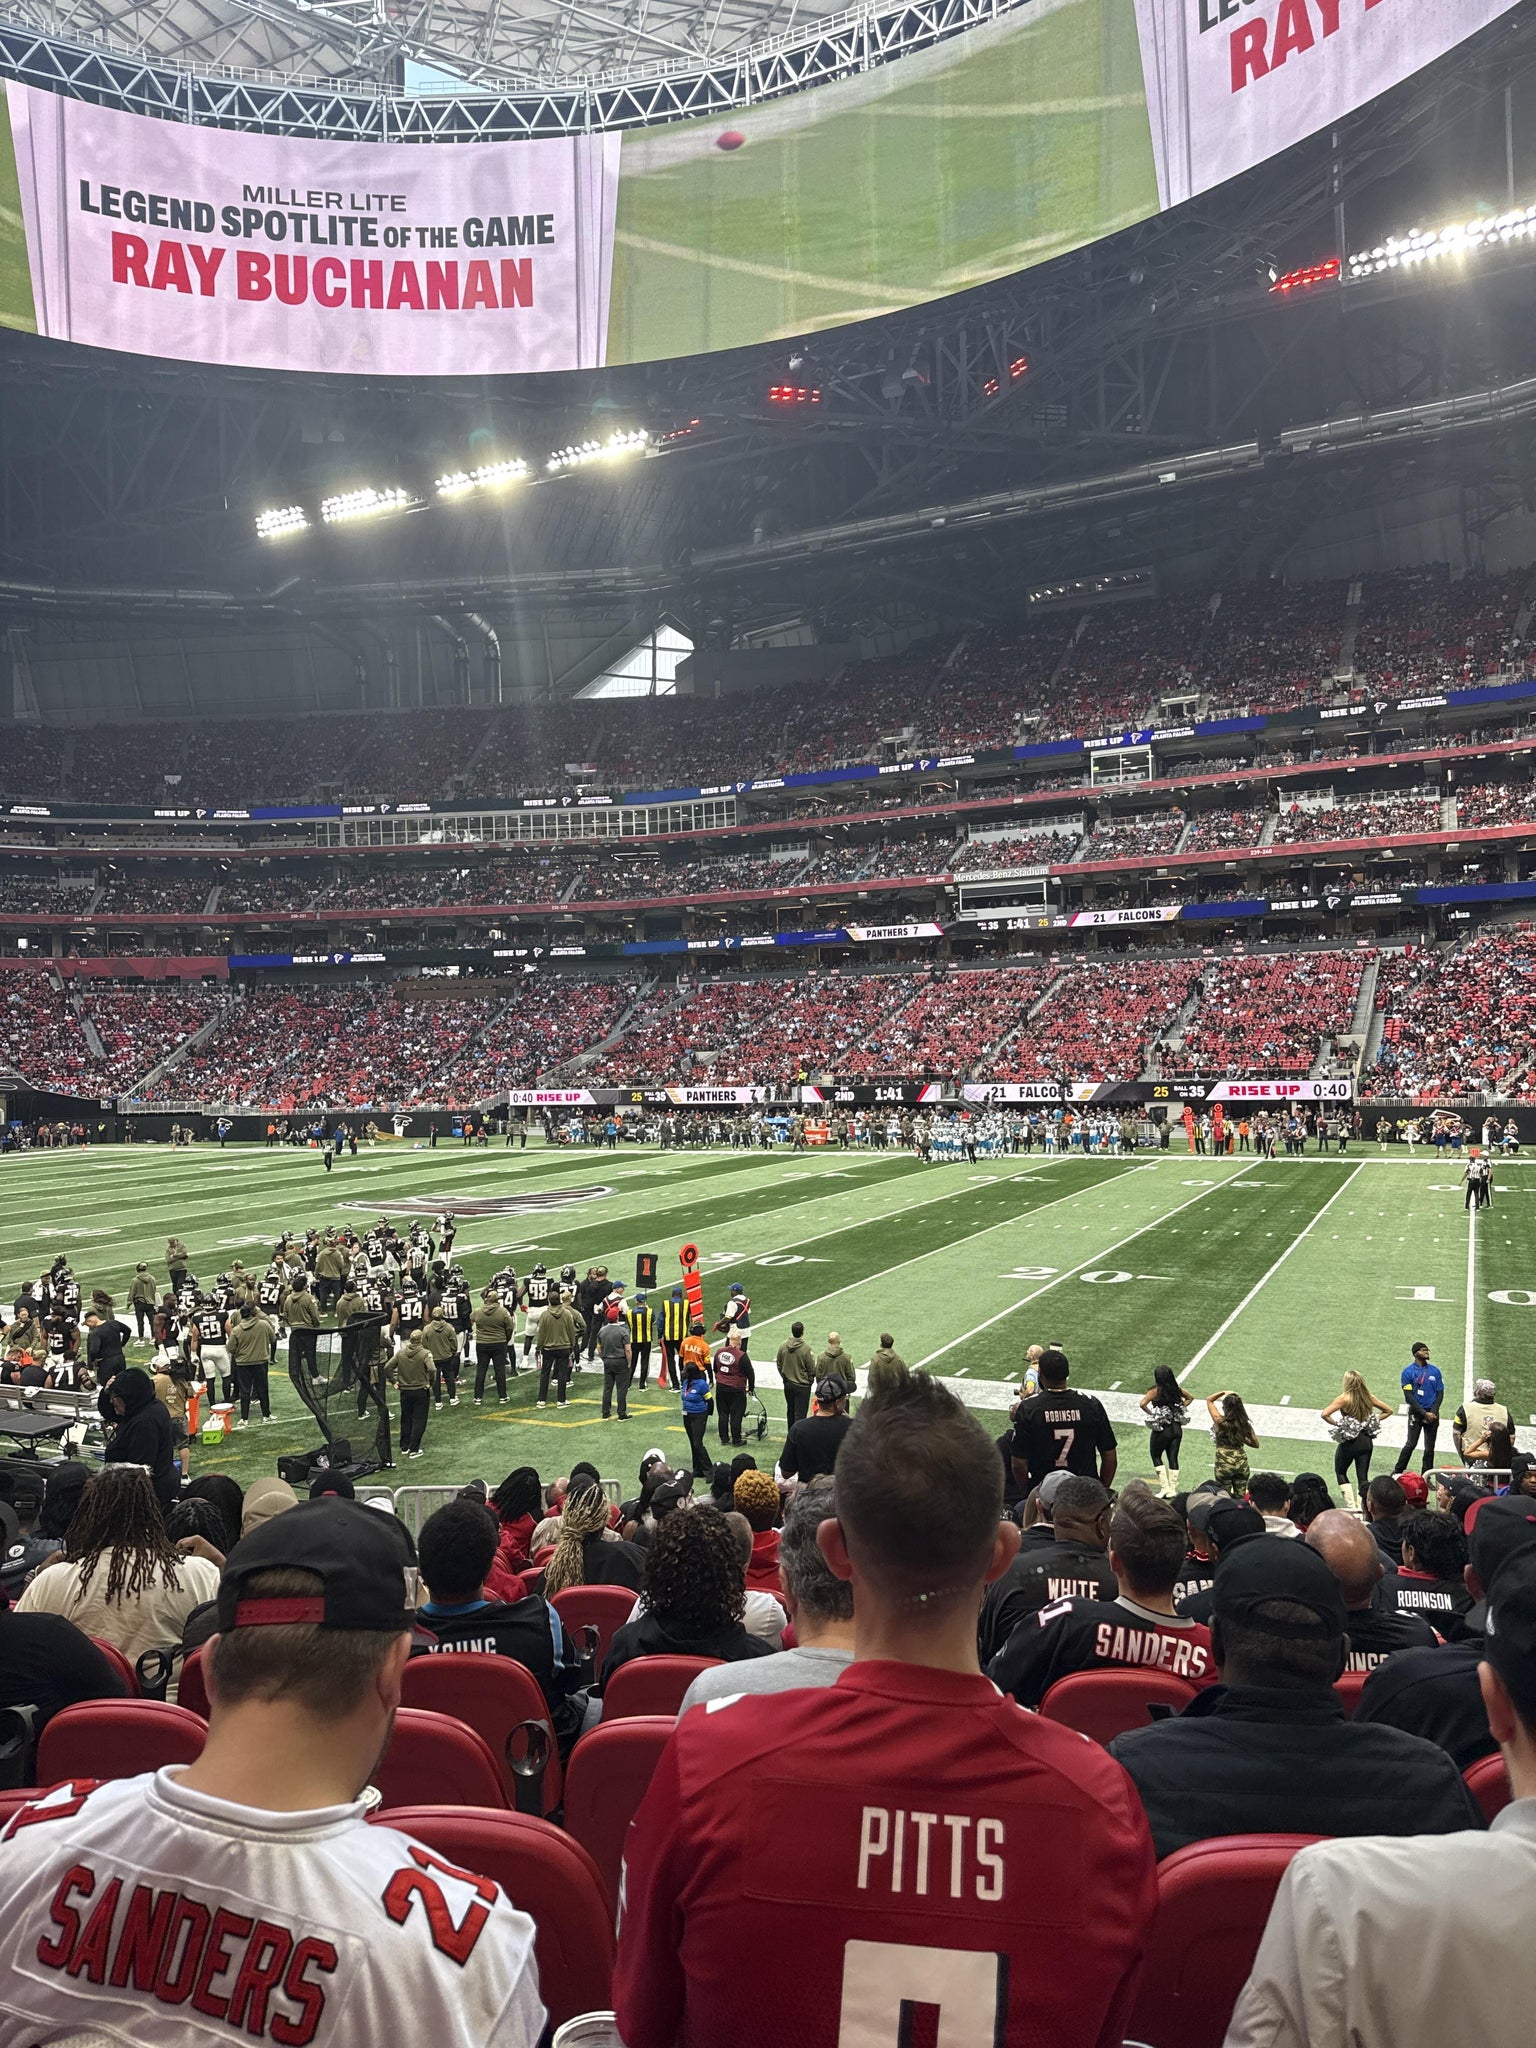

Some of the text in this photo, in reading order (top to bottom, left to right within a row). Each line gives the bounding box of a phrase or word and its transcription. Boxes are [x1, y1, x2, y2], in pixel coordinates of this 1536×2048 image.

[1230, 0, 1340, 94] RAY
[241, 183, 408, 213] MILLER LITE
[79, 179, 556, 249] LEGEND SPOTLITE OF THE GAME
[110, 230, 535, 310] RAY BUCHANAN
[1320, 706, 1367, 718] RISE UP
[1083, 736, 1124, 748] RISE UP
[953, 870, 1012, 882] Mercedes-Benz
[1014, 866, 1048, 878] Stadium
[1270, 899, 1319, 910] RISE UP
[1037, 918, 1049, 926] 25
[1093, 909, 1162, 923] 21 FALCONS
[987, 921, 999, 930] 35
[1006, 918, 1030, 929] 1:41
[866, 926, 919, 938] PANTHERS 7
[631, 1092, 643, 1101] 25
[655, 1091, 667, 1102] 35
[686, 1089, 757, 1102] PANTHERS 7
[834, 1091, 855, 1101] 2ND
[874, 1086, 904, 1101] 1:41
[991, 1086, 1074, 1098] 21 FALCOS
[1153, 1086, 1169, 1098] 25
[1189, 1085, 1205, 1097] 35
[1228, 1083, 1347, 1097] RISE UP 0:40
[513, 1093, 581, 1103] 0:40 RISE UP
[260, 1287, 280, 1304] 24
[401, 1301, 422, 1320] 94
[54, 1366, 74, 1388] 71
[1044, 1409, 1081, 1423] ROBINSON
[1053, 1428, 1075, 1467] 7
[1047, 1577, 1100, 1602] WHITE
[1397, 1589, 1452, 1611] ROBINSON
[1094, 1622, 1209, 1679] SANDERS
[857, 1806, 1005, 1901] PITTS
[36, 1864, 338, 2047] SANDERS
